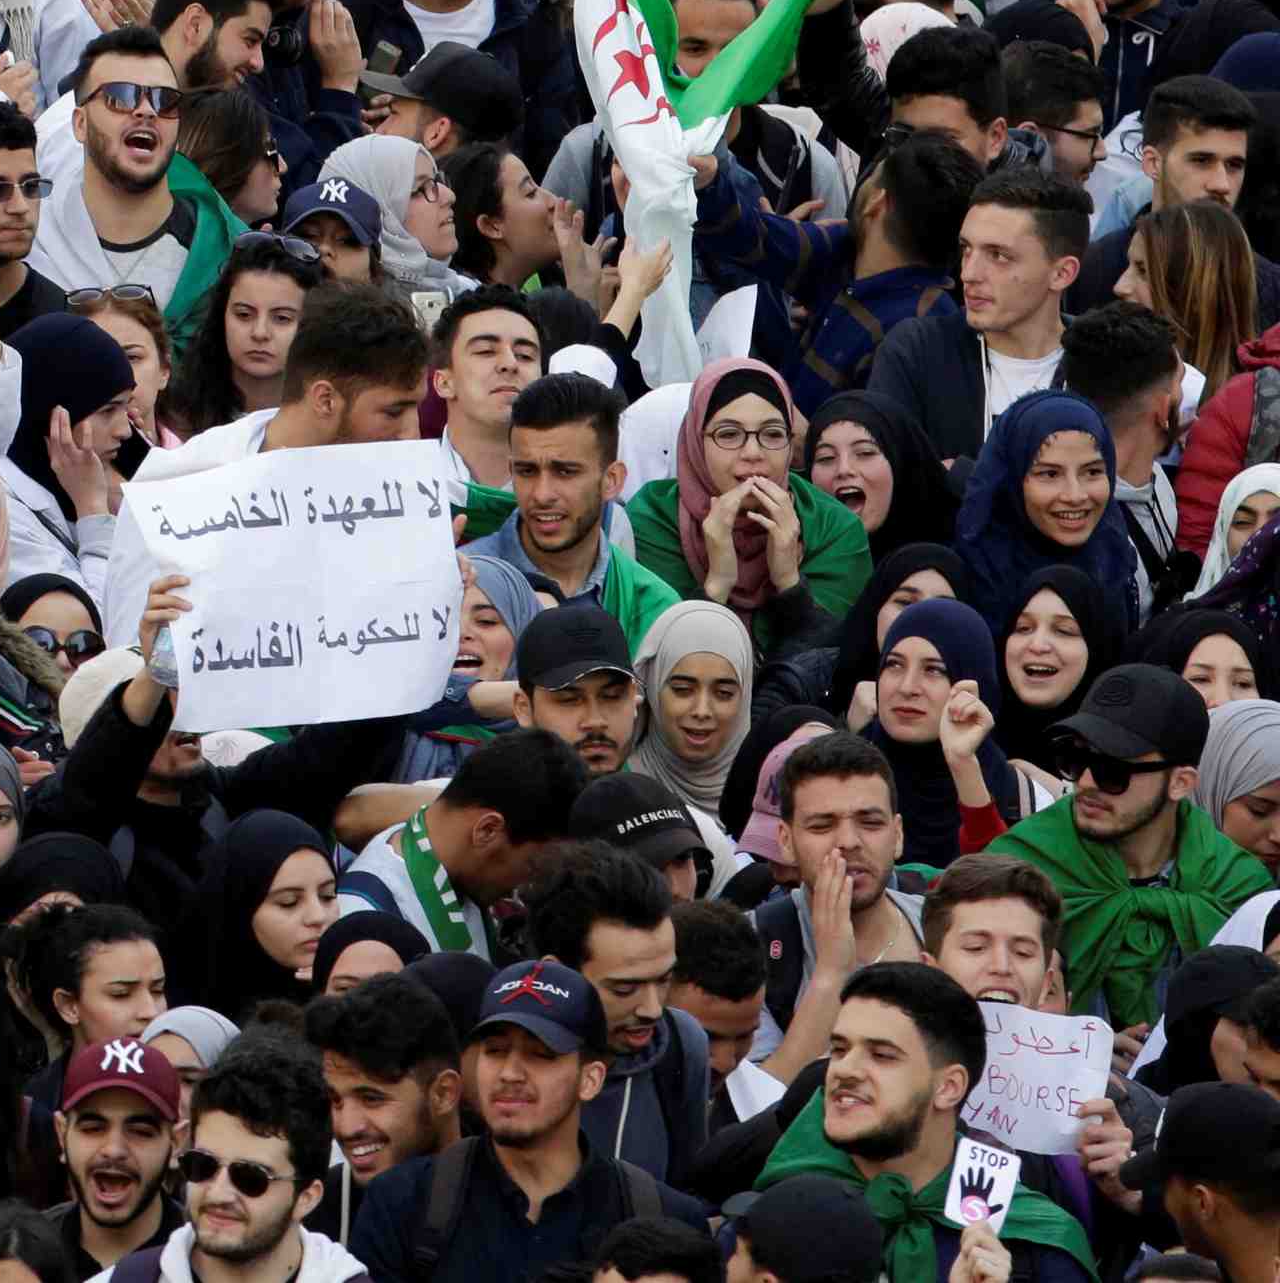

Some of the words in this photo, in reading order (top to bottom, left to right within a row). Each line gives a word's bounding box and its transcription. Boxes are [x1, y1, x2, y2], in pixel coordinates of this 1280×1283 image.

[319, 178, 350, 203] NY
[151, 490, 291, 541] الخامسة
[303, 480, 405, 536] للعهدة
[417, 478, 443, 519] لا
[317, 613, 420, 655] للحكومة
[432, 603, 451, 641] لا
[191, 619, 303, 674] الفاسدة
[100, 1038, 145, 1074] NY
[986, 1063, 1085, 1120] BOURSE
[969, 1146, 1009, 1171] STOP
